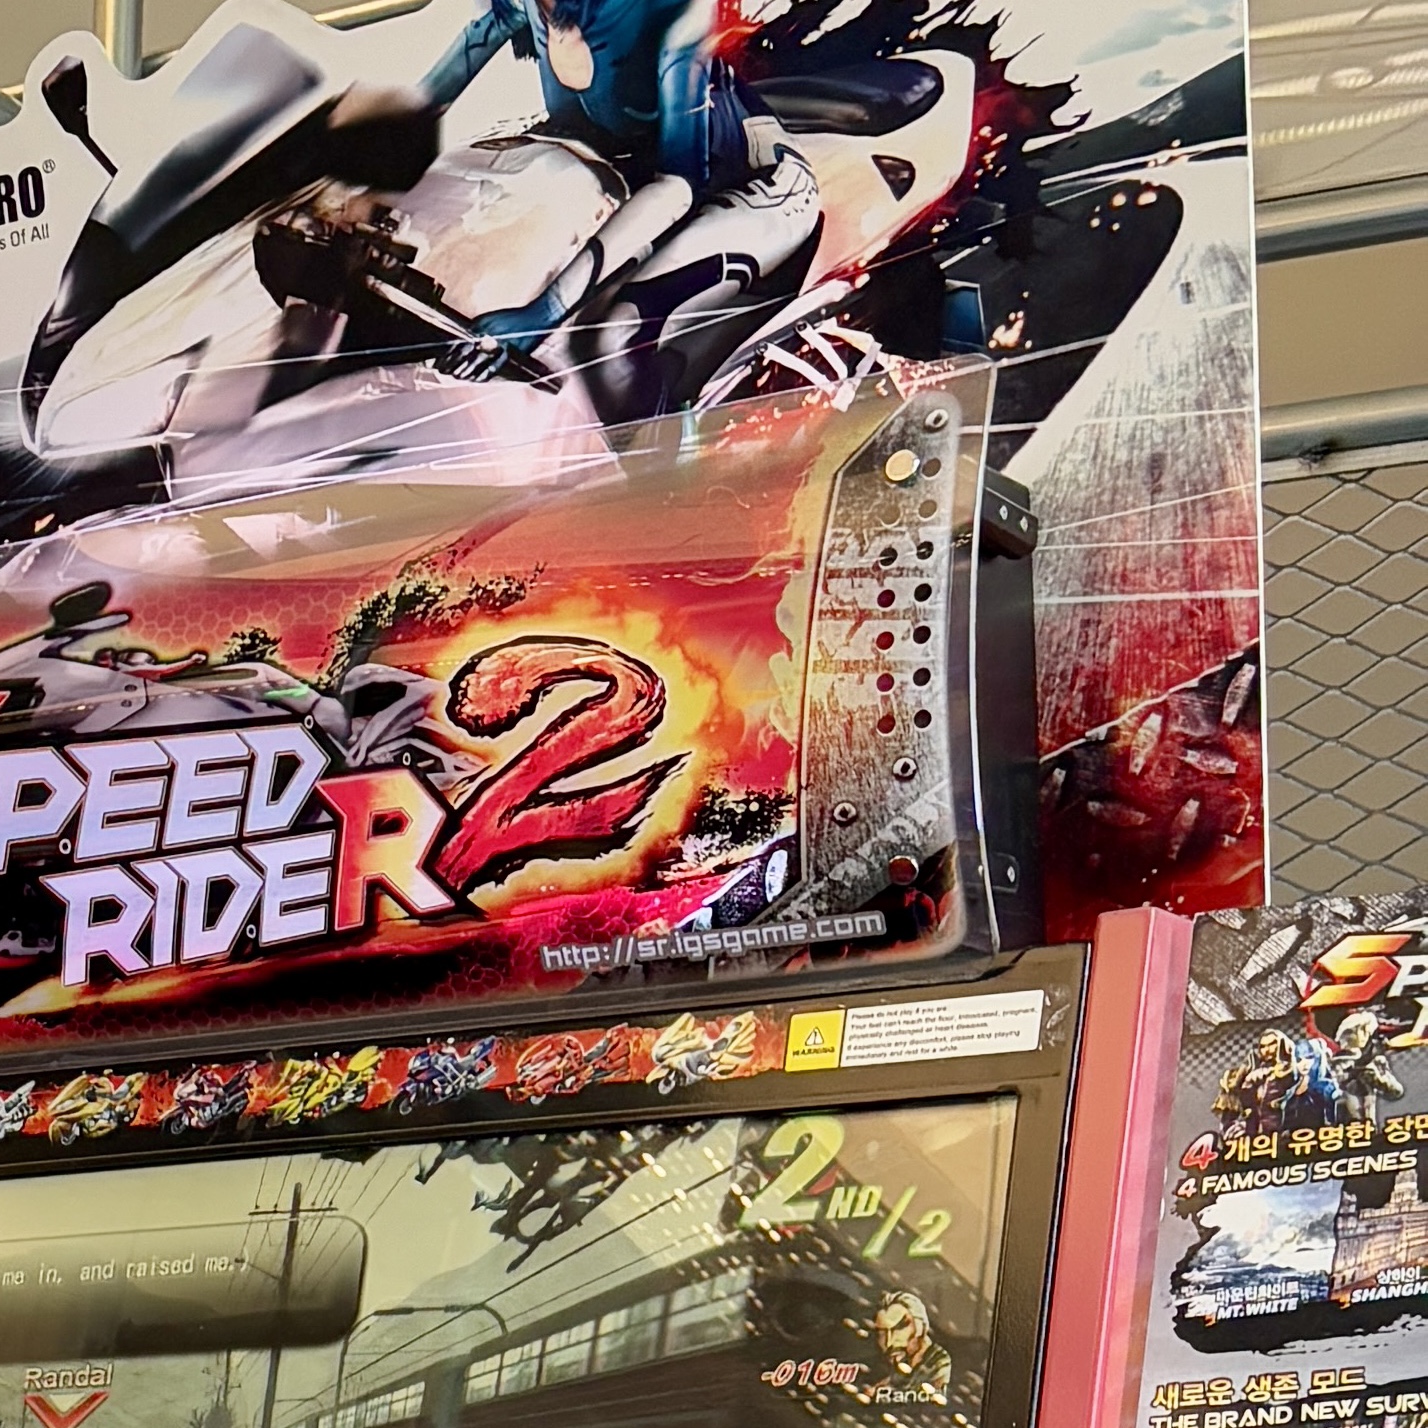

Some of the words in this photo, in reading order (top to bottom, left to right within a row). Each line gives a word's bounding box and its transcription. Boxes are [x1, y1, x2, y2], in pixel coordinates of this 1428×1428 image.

[10, 231, 26, 247] Of
[31, 224, 50, 240] All
[41, 768, 456, 987] RIDER
[542, 910, 887, 971] http://sr.igsgame.com
[1180, 1133, 1218, 1170] 4
[1224, 1132, 1278, 1162] 개의
[1288, 1120, 1374, 1156] 유명한
[1177, 1177, 1197, 1198] 4
[1202, 1164, 1307, 1194] FAMOUS
[1313, 1150, 1418, 1179] SCENES
[80, 1260, 115, 1282] and
[126, 1253, 195, 1278] raised
[24, 1364, 114, 1391] Randal
[1152, 1378, 1232, 1409] 새로운
[1245, 1372, 1300, 1402] 생존
[1310, 1368, 1367, 1396] 모드
[1301, 1398, 1360, 1421] NEW
